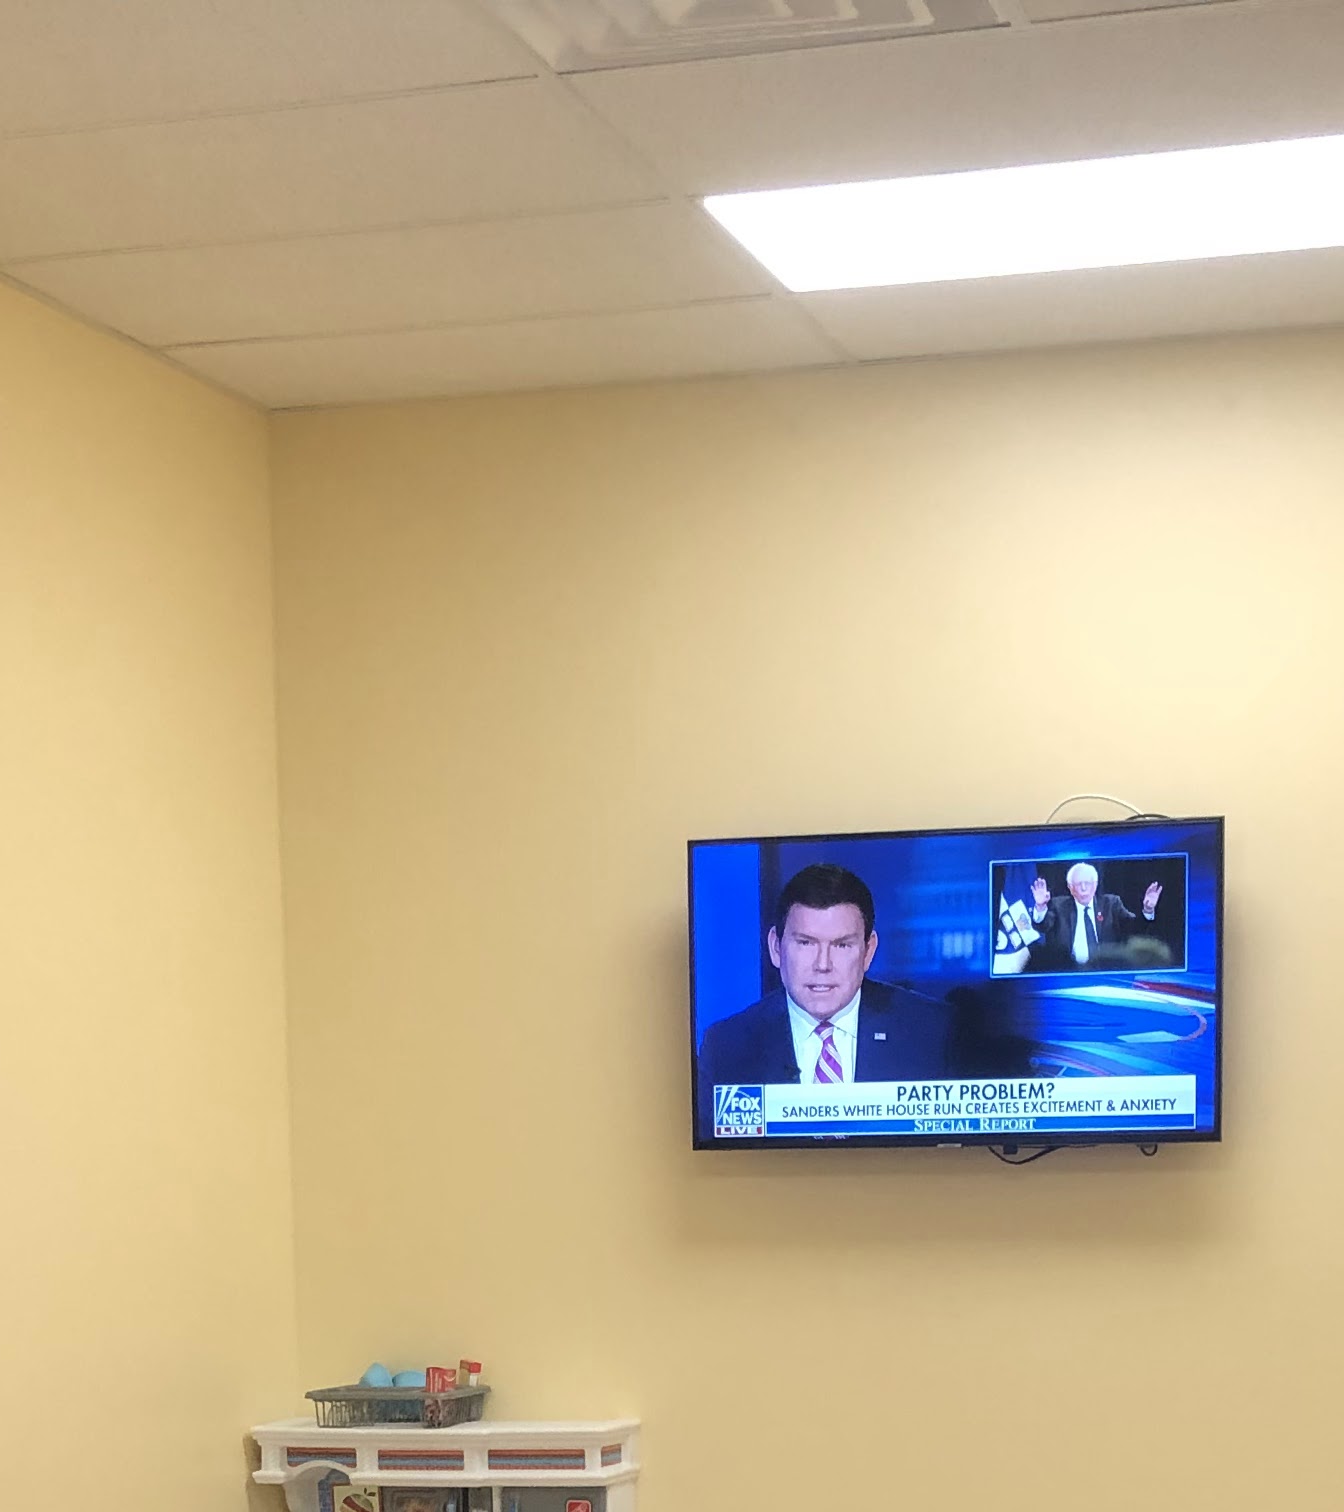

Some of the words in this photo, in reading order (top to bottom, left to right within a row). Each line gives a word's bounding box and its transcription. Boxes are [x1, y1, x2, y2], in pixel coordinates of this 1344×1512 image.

[897, 1085, 954, 1102] PARTY
[959, 1082, 1055, 1101] PROBLEM?
[731, 1096, 761, 1111] FOX
[782, 1104, 840, 1118] SANDERS
[843, 1104, 882, 1117] WHITE
[886, 1103, 930, 1116] HOUSE
[934, 1103, 961, 1115] RUN
[965, 1101, 1019, 1115] CREATES
[1023, 1100, 1102, 1114] EXCITEMENT
[1106, 1099, 1116, 1112] &
[1120, 1098, 1177, 1111] ANXIETY
[722, 1112, 762, 1125] NEWS
[913, 1118, 974, 1132] SPECIAL
[979, 1117, 1037, 1132] REPORT
